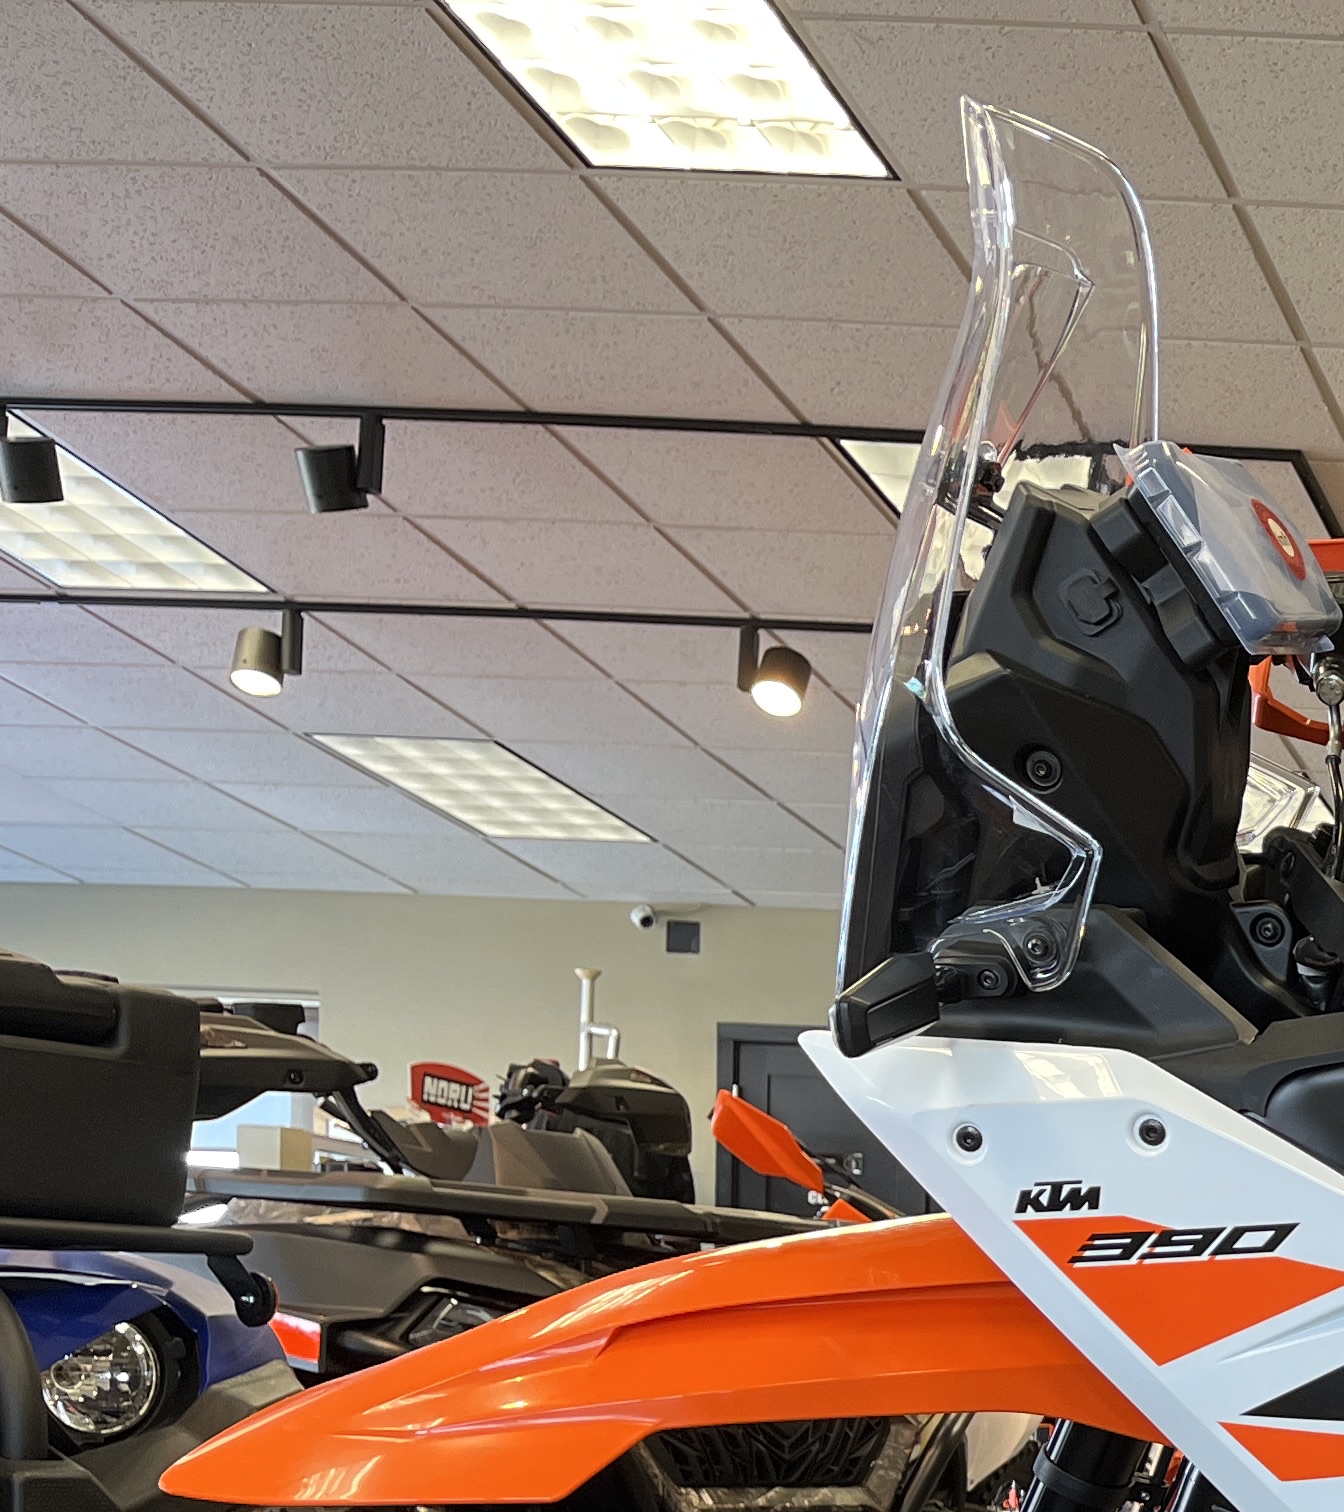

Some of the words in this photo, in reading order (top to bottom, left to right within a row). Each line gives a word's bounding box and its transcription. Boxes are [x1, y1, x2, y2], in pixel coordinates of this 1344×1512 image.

[423, 1075, 473, 1111] NORU
[1014, 1180, 1101, 1213] KTM
[1066, 1221, 1300, 1264] 390
